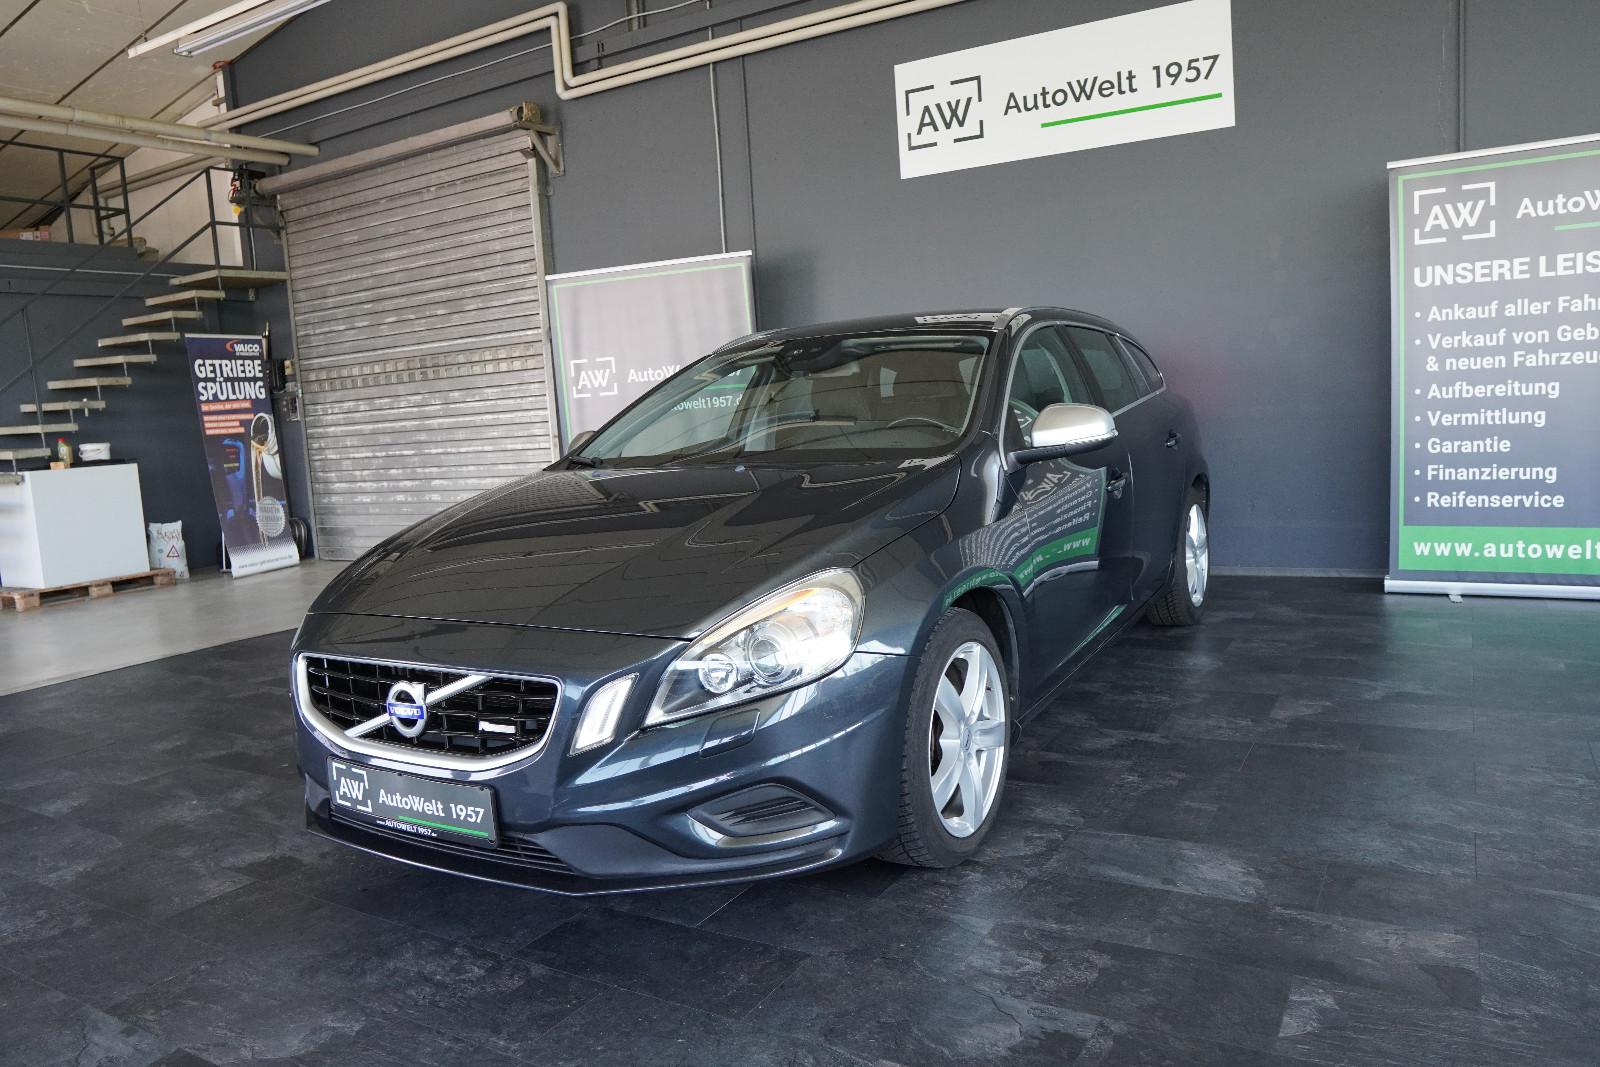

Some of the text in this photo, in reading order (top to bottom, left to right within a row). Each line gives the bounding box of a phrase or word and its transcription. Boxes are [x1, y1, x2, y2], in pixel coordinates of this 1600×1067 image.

[1003, 54, 1220, 116] AutoWelt 1957
[916, 97, 973, 135] AW
[1424, 199, 1486, 232] AW
[1413, 250, 1600, 287] UNSERE LEIS
[1427, 300, 1499, 322] Ankauf
[1504, 298, 1551, 317] aller
[1427, 322, 1599, 349] Verkauf von Geb
[233, 343, 260, 352] VAICO
[194, 359, 264, 378] GETRIEBE
[1426, 348, 1600, 371] & neuen Fahrzeu
[197, 377, 266, 401] SPÜLUNG
[577, 368, 611, 389] AW
[1427, 380, 1560, 399] Aufbereitung
[1427, 408, 1547, 427] Vermittlung
[1427, 436, 1511, 453] Garantie
[1427, 464, 1558, 483] Finanzierung
[1427, 491, 1565, 508] Reifenservice
[339, 776, 364, 801] AW
[378, 789, 485, 824] AutoWelt 1957
